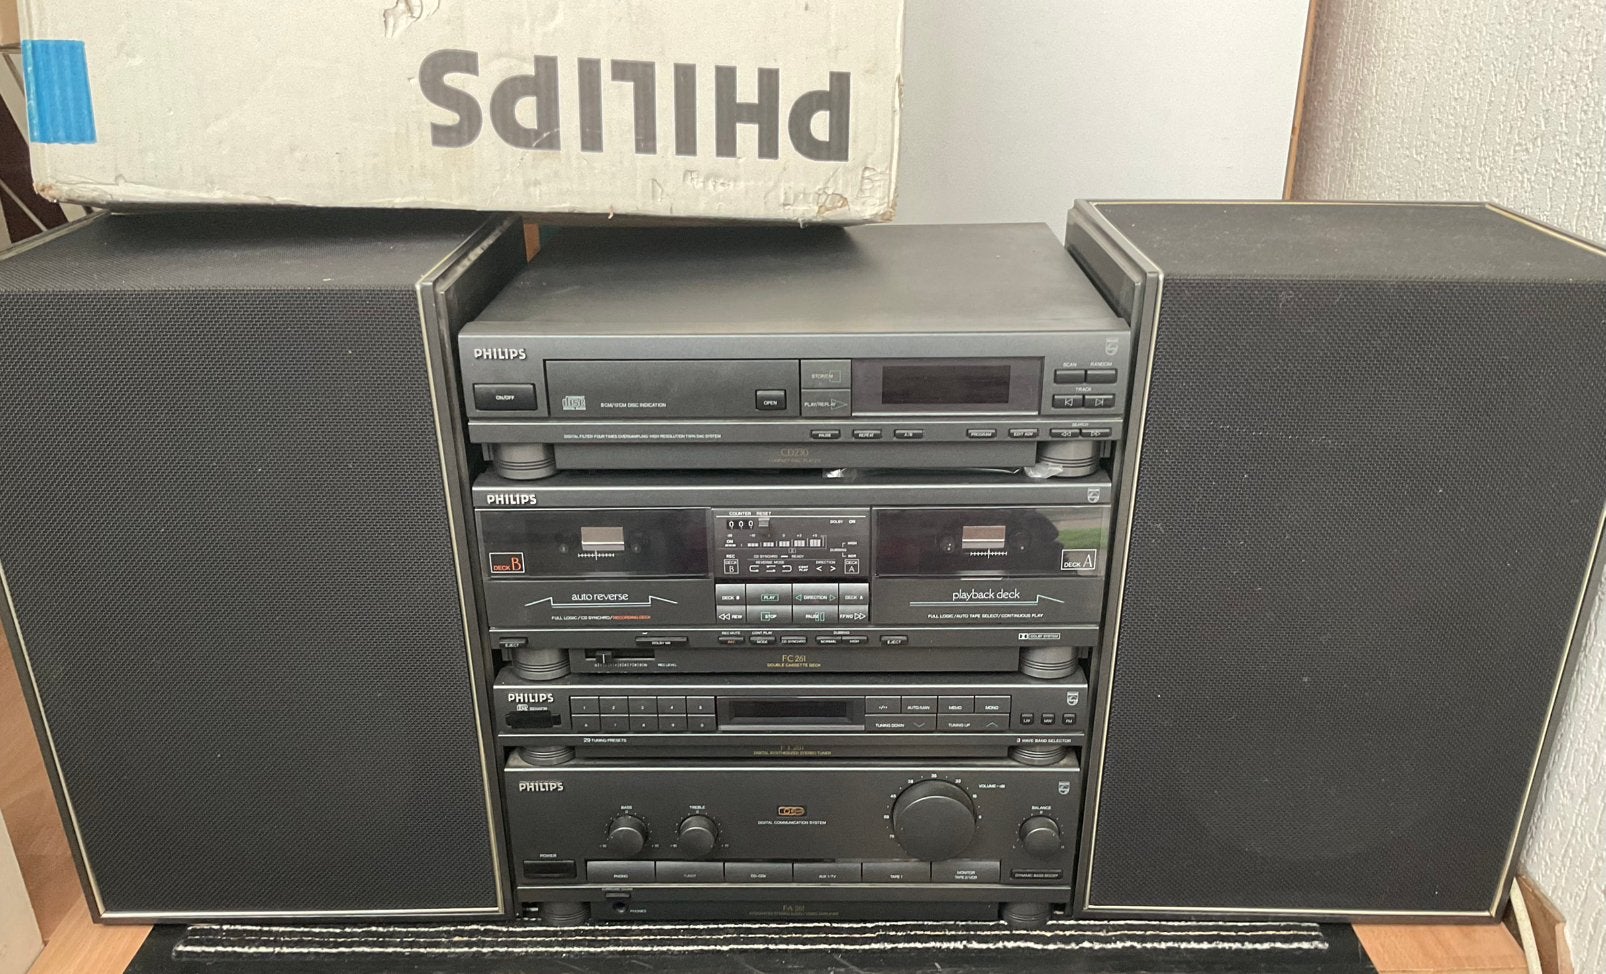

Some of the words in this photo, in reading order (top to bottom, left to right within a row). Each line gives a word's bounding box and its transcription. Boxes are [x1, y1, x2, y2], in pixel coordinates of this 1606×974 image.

[418, 49, 852, 163] PHILIPS
[473, 348, 527, 360] PHILIPS
[487, 494, 537, 505] PHILIPS
[511, 556, 521, 571] B
[1082, 553, 1093, 567] A
[729, 565, 735, 573] B
[848, 565, 855, 573] A
[571, 593, 592, 601] auto
[952, 588, 995, 601] playback
[996, 588, 1020, 599] deck
[782, 654, 794, 662] FC
[508, 693, 554, 703] PHILIPS
[518, 782, 564, 792] PHILIPS
